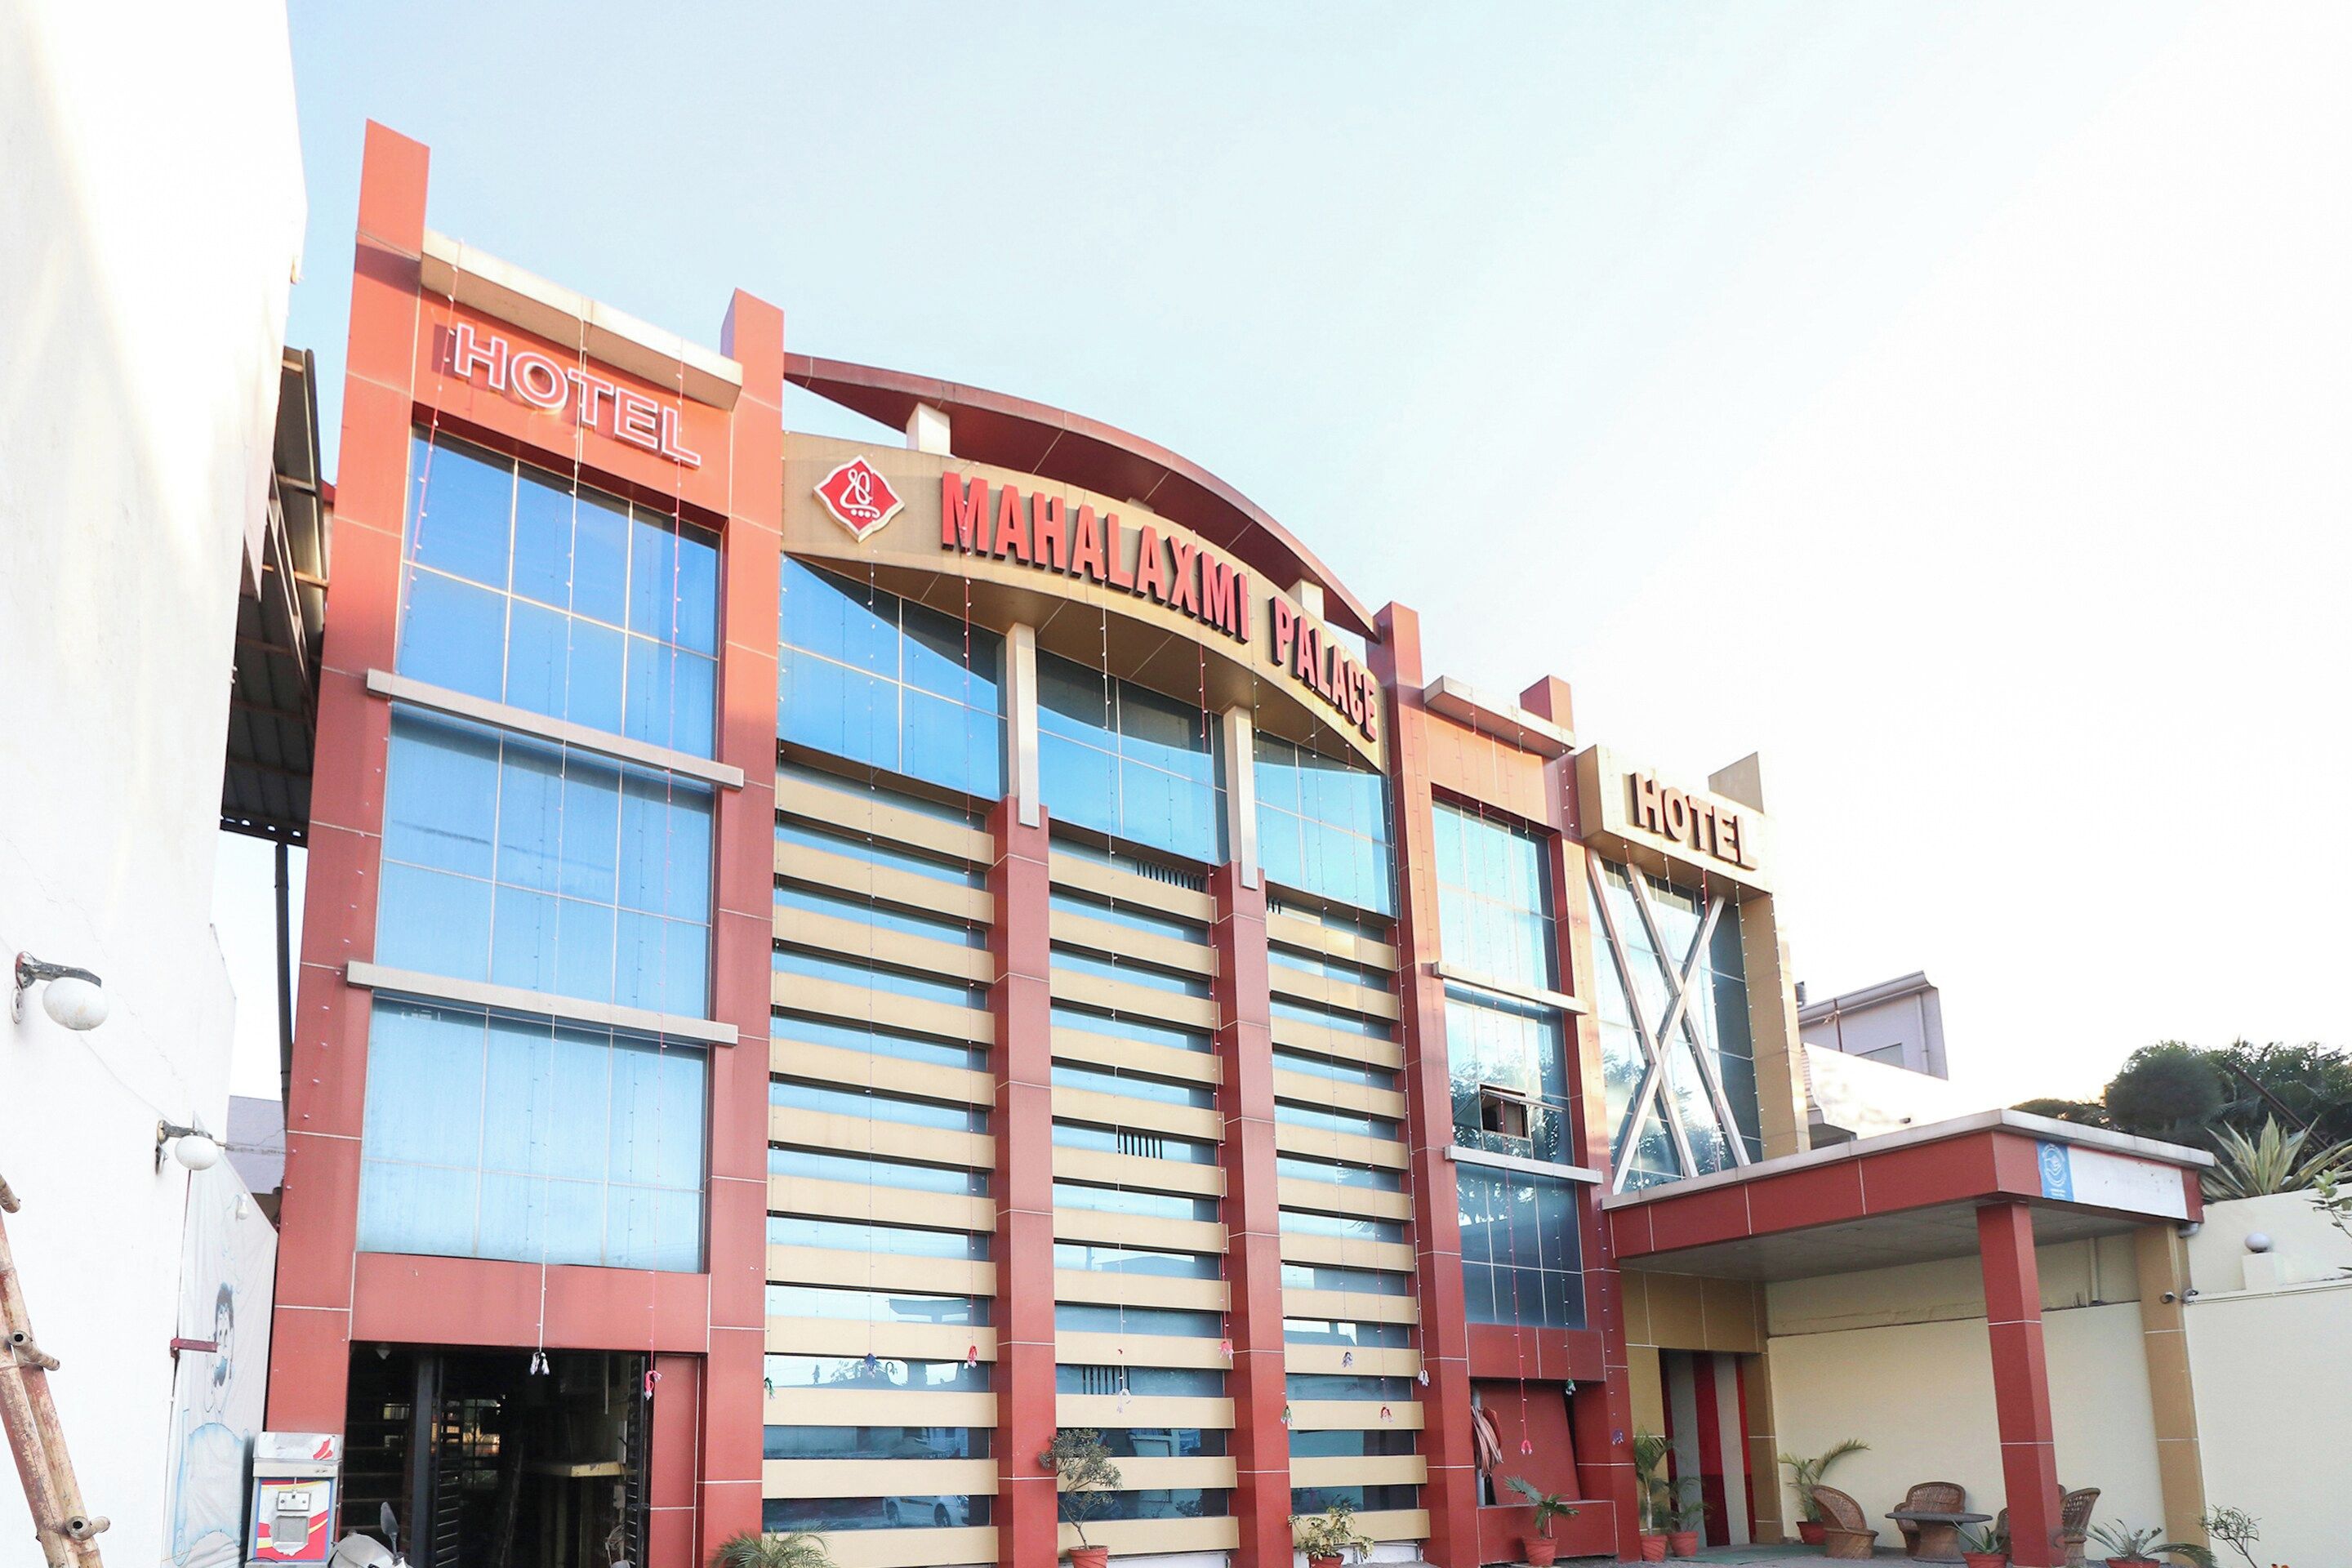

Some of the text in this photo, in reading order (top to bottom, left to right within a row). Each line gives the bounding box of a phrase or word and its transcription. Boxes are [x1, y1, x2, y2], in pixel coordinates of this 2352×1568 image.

[453, 322, 702, 470] HOTEL
[941, 471, 1377, 743] MAHALAXMI PALACE
[1630, 773, 1758, 871] HOTEL
